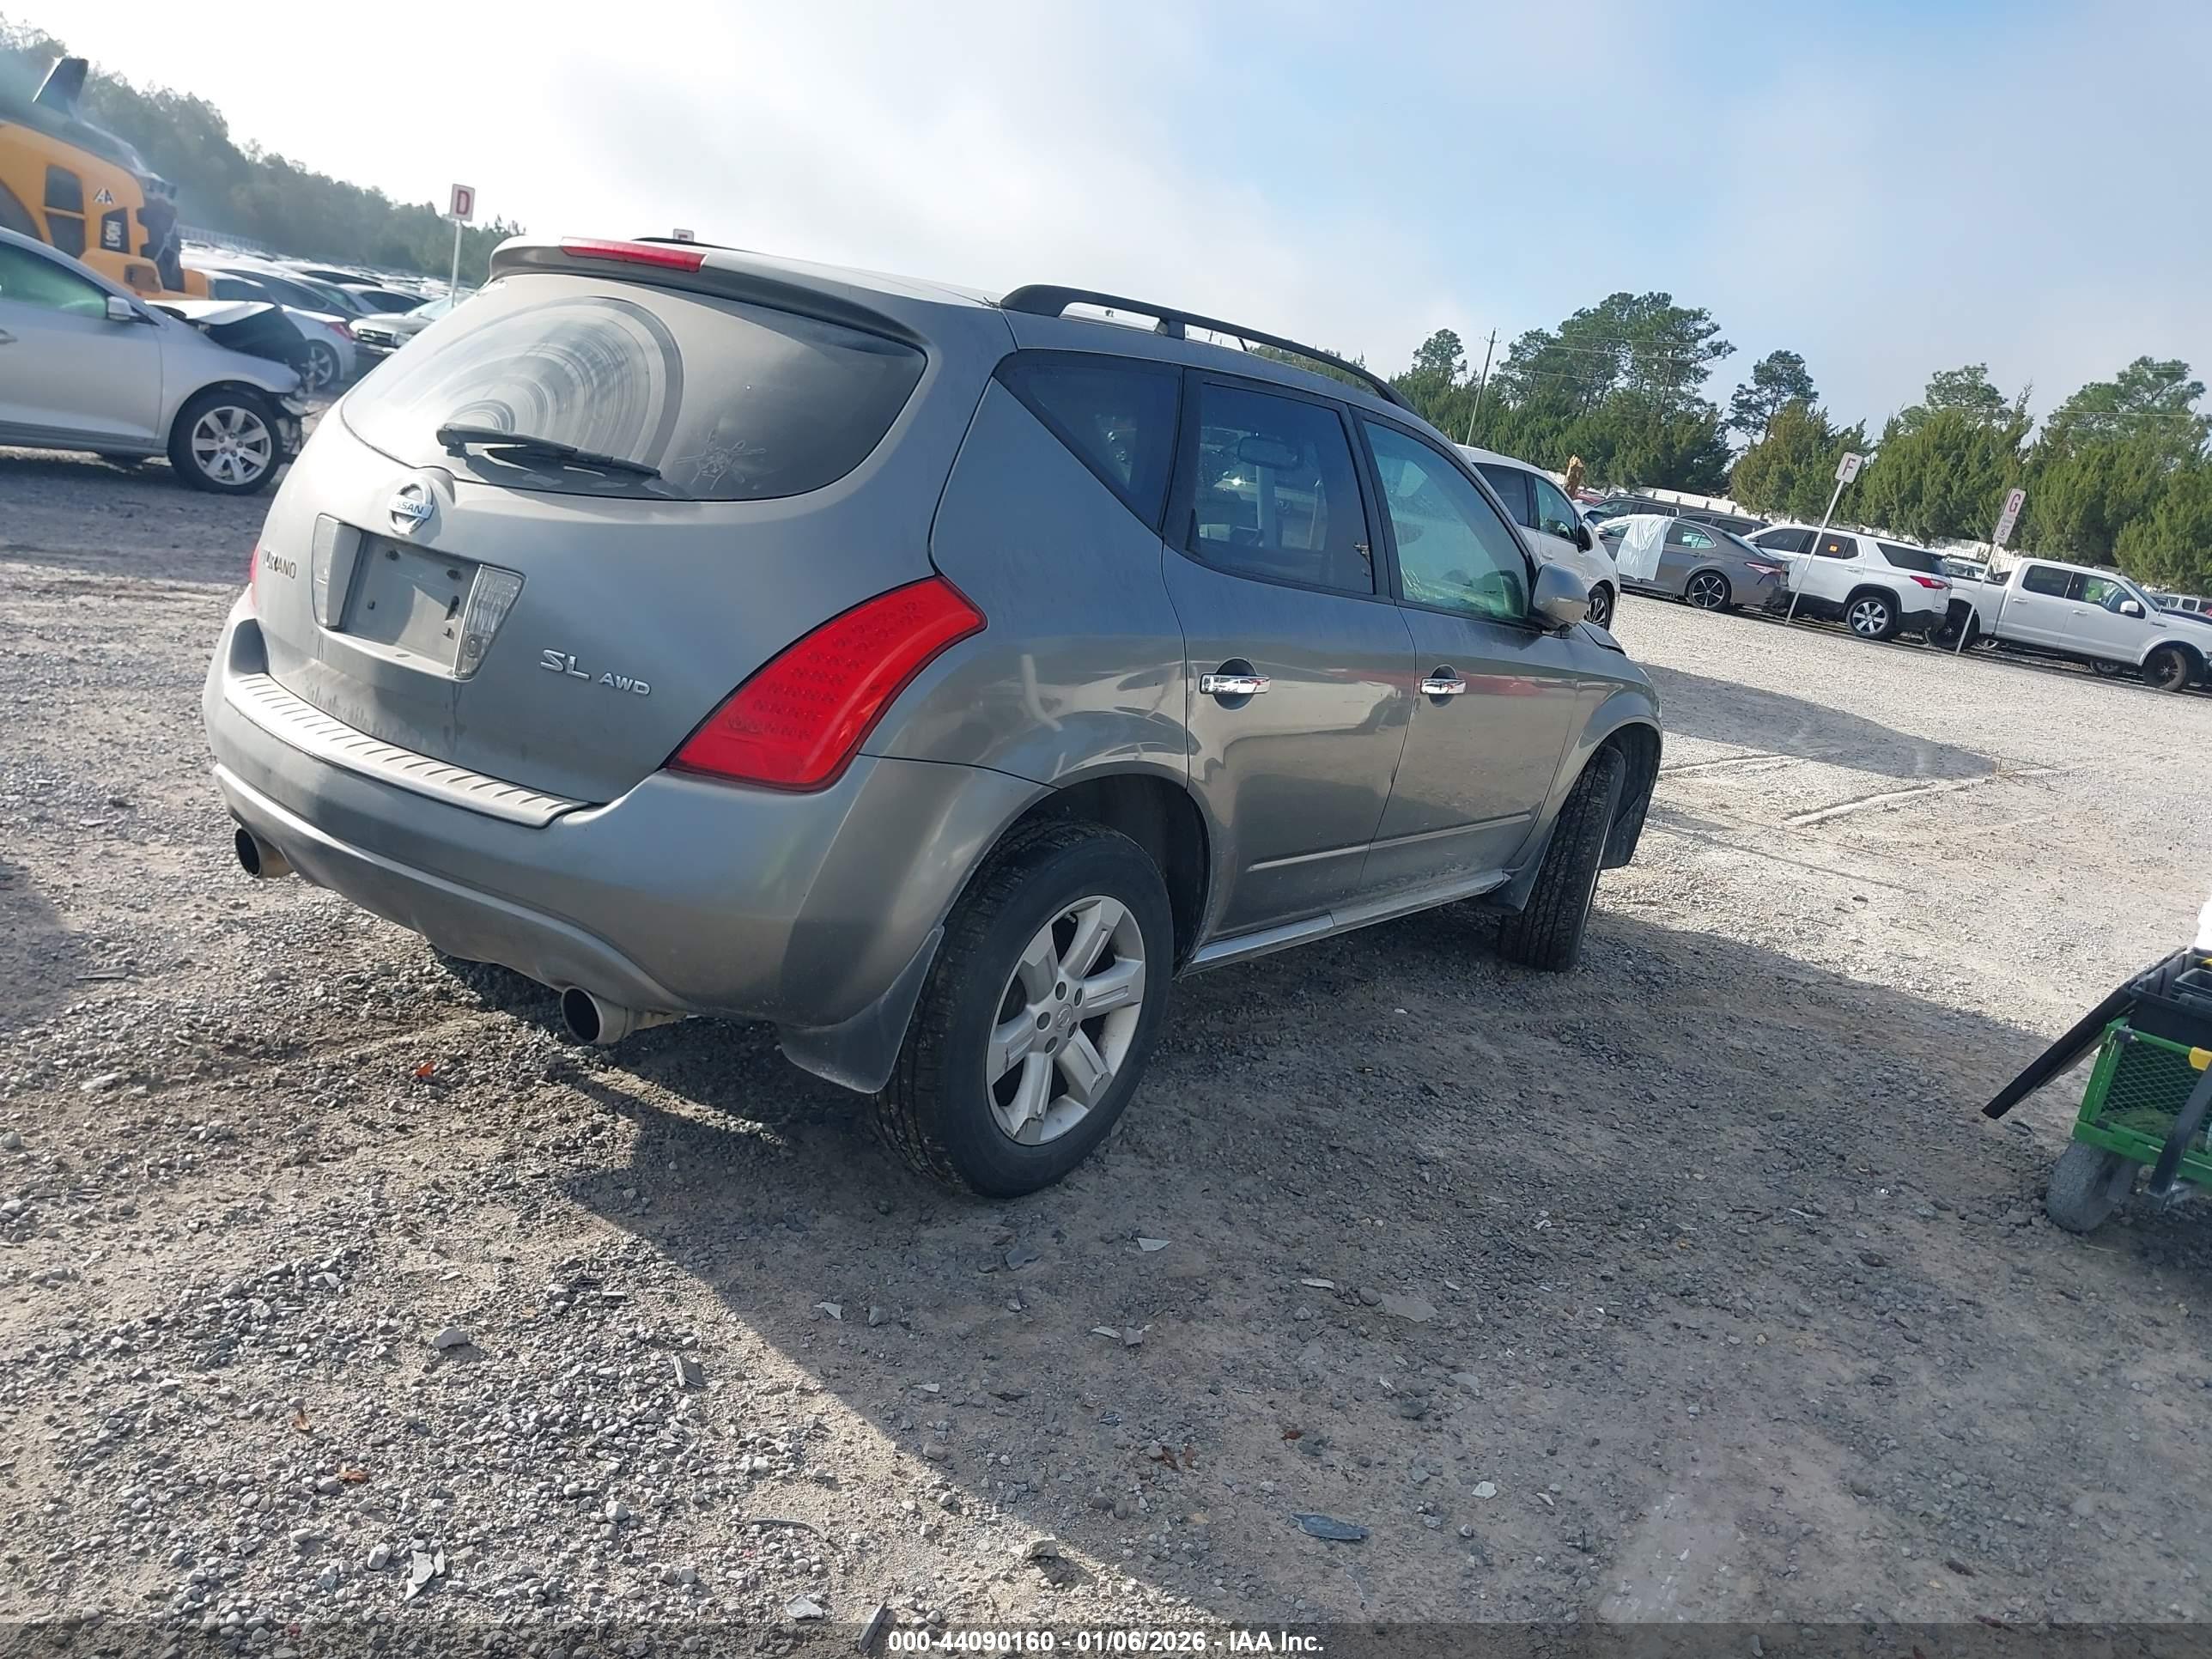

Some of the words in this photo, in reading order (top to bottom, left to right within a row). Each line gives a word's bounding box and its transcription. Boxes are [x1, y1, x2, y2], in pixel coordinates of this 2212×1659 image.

[456, 190, 471, 216] D
[1842, 457, 1856, 476] F
[2008, 493, 2021, 513] G
[540, 648, 592, 680] SL
[599, 672, 652, 696] AWD
